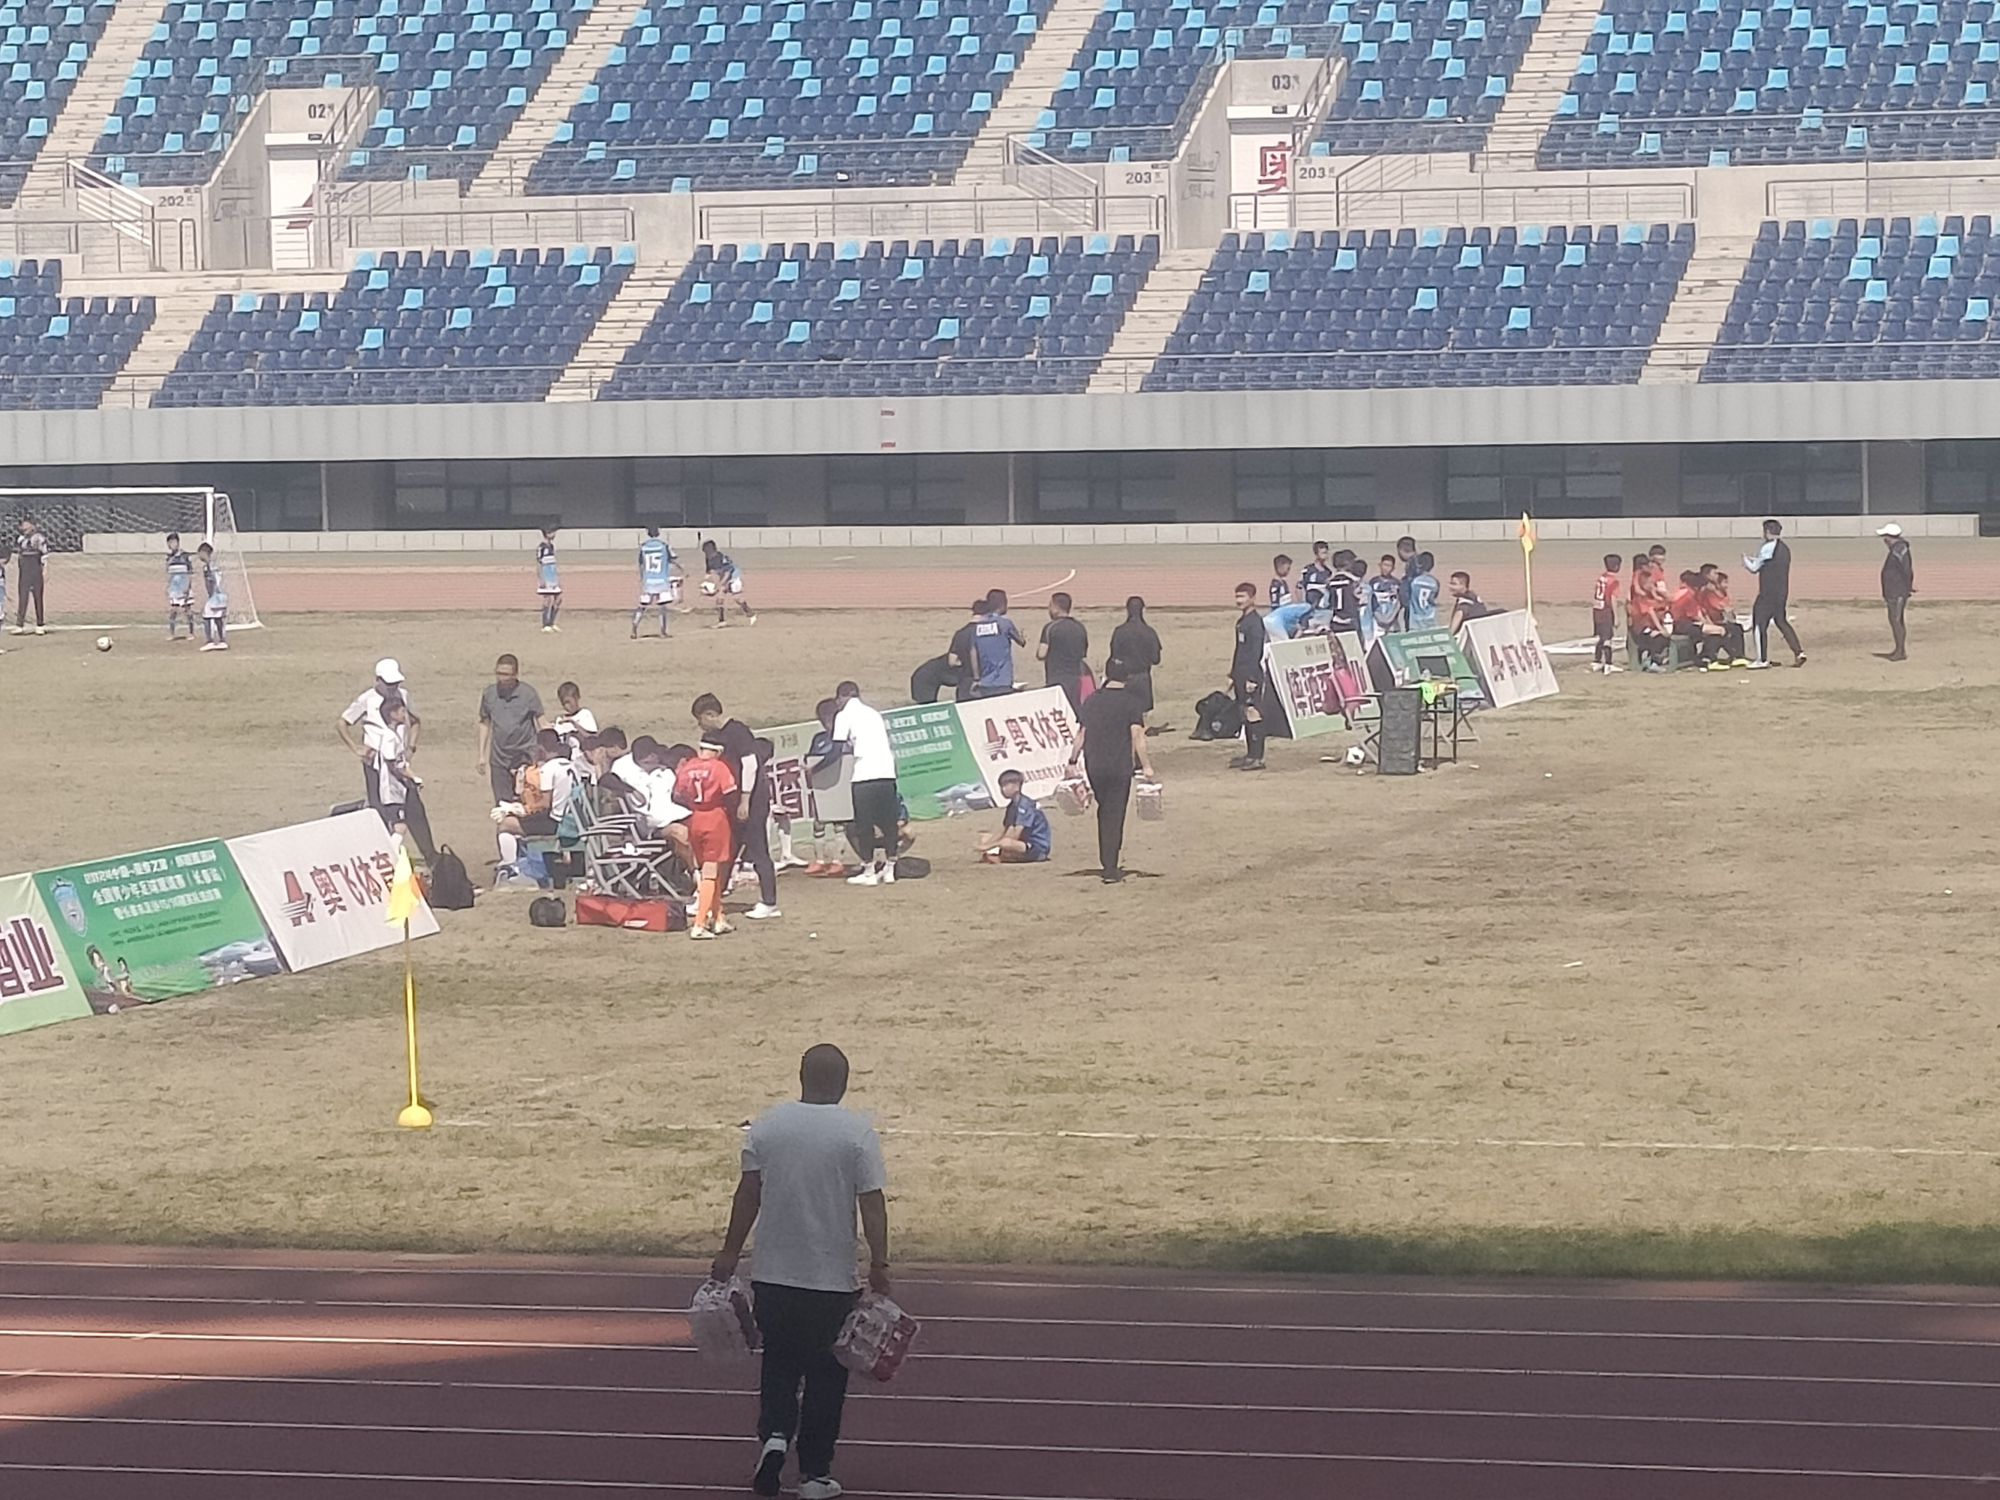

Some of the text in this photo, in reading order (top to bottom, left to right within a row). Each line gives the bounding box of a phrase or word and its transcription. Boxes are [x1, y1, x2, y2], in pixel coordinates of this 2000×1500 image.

[645, 553, 662, 573] 15
[309, 850, 396, 916] 奥飞体育
